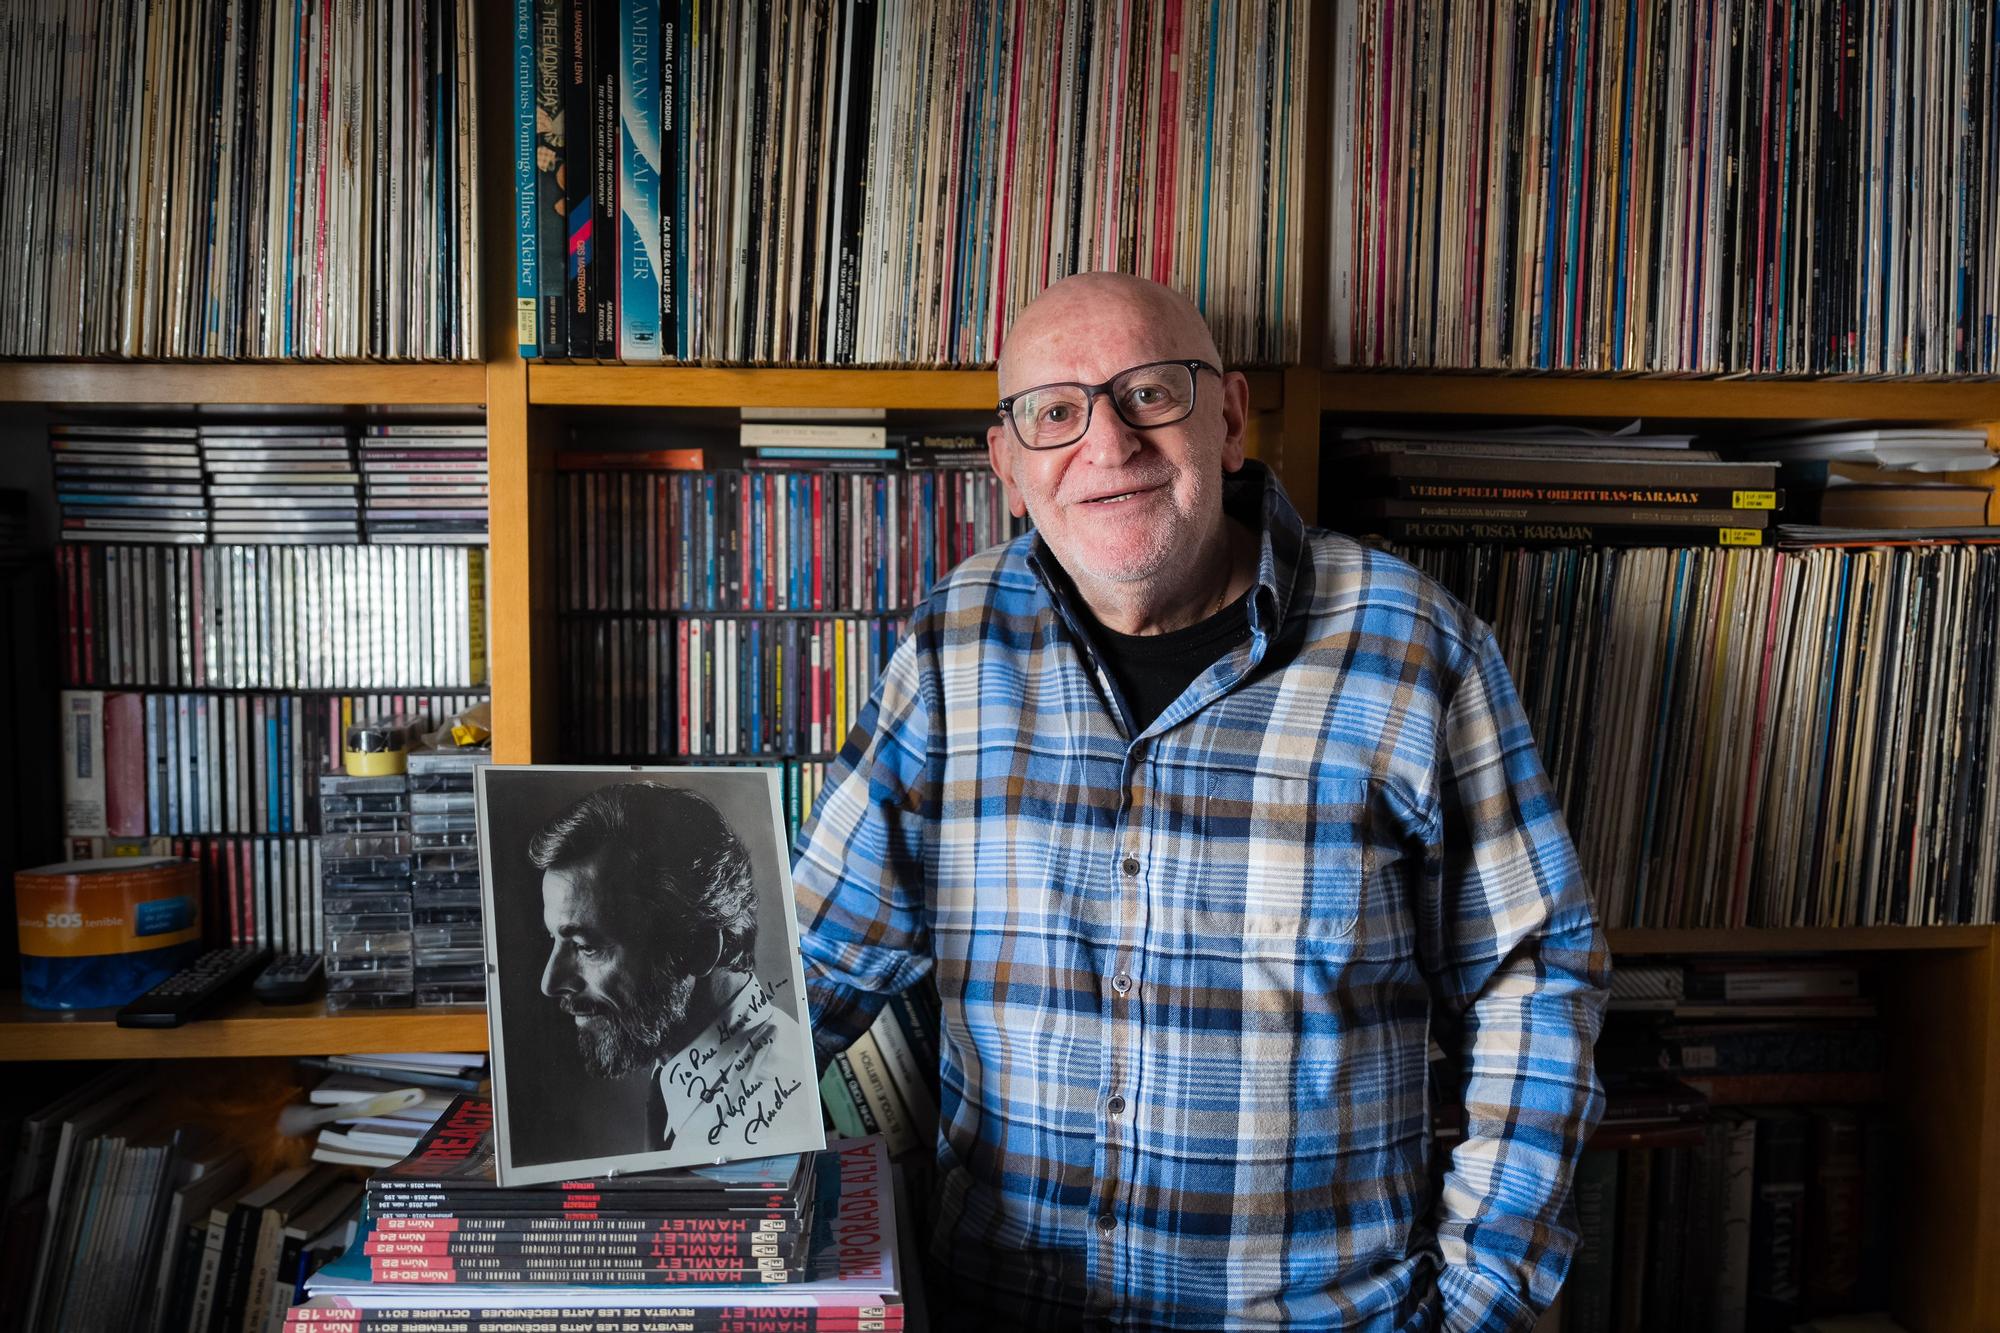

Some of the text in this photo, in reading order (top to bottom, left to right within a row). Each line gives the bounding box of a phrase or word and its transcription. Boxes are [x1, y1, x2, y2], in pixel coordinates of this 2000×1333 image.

[632, 2, 649, 99] AMERICAN
[542, 8, 559, 107] TREEMONISHA
[519, 44, 534, 109] Cotrubas
[663, 22, 674, 131] ORIGINAL CAST RECORDING
[598, 85, 606, 98] THE
[598, 124, 606, 147] CARTE
[518, 115, 533, 178] Domingo
[605, 75, 614, 218] GILBERT AND SULLIVAN THE GONDOLIERS
[598, 148, 606, 171] OPERA
[598, 172, 606, 206] COMPANY
[520, 182, 536, 228] Milnes
[663, 216, 671, 232] RCA
[663, 233, 671, 248] RED
[520, 234, 537, 286] Kleiber
[663, 249, 671, 268] SEAL
[576, 240, 587, 313] CBS MASTERWORKS
[663, 294, 671, 313] 5054
[598, 309, 606, 342] RECORDS
[606, 300, 614, 342] ARABESQUE
[1408, 484, 1700, 505] VERDI PRELUDIOS Y OBERTURAS KARAJAN
[1405, 522, 1593, 541] PUCCINI TOSCA KARAJAN
[46, 912, 83, 929] SOS
[669, 1063, 692, 1086] To
[859, 1103, 876, 1128] JOHN
[839, 1143, 878, 1184] ALTA
[388, 1219, 405, 1229] 25
[406, 1218, 435, 1229] Núm
[466, 1219, 481, 1229] 2012
[483, 1219, 505, 1229] ABRIL
[574, 1219, 590, 1230] ARTS
[592, 1219, 604, 1230] LES
[606, 1219, 616, 1230] DE
[618, 1219, 646, 1230] REVISTA
[659, 1219, 746, 1231] HAMLET
[379, 1232, 395, 1242] 24
[396, 1231, 426, 1242] Núm
[459, 1232, 475, 1242] 2012
[477, 1232, 497, 1242] MARÇ
[565, 1232, 582, 1243] ARTS
[583, 1232, 595, 1243] LES
[597, 1232, 607, 1243] DE
[608, 1232, 637, 1243] REVISTA
[651, 1231, 738, 1243] HAMLET
[838, 1187, 882, 1281] TEMPORADA
[377, 1243, 395, 1254] 23
[395, 1243, 423, 1254] Núm
[450, 1244, 466, 1254] 2012
[468, 1244, 495, 1255] FEBRER
[563, 1245, 580, 1255] ARTS
[582, 1245, 594, 1255] LES
[596, 1245, 605, 1255] DE
[606, 1245, 636, 1255] REVISTA
[650, 1244, 738, 1256] HAMLET
[381, 1258, 395, 1268] 22
[395, 1257, 428, 1269] Núm
[459, 1258, 473, 1268] 2012
[474, 1258, 500, 1269] GENER
[571, 1258, 587, 1268] ARTS
[588, 1258, 601, 1268] LES
[602, 1258, 612, 1268] DE
[613, 1258, 642, 1268] REVISTA
[656, 1257, 744, 1269] HAMLET
[382, 1270, 419, 1281] 20-21
[421, 1270, 448, 1281] Núm
[467, 1270, 483, 1280] 2011
[484, 1270, 521, 1281] NOVEMBRE
[573, 1270, 590, 1281] ARTS
[591, 1270, 604, 1281] LES
[605, 1270, 615, 1281] DE
[616, 1270, 646, 1281] REVISTA
[664, 1270, 742, 1281] HAMLET
[298, 1308, 321, 1320] 19
[377, 1309, 410, 1319] 2011
[412, 1309, 471, 1319] OCTUBRE
[480, 1308, 560, 1319] ESCÈNIQUES
[563, 1308, 596, 1318] ARTS
[597, 1308, 622, 1318] LES
[624, 1308, 641, 1318] DE
[644, 1308, 696, 1318] REVISTA
[719, 1306, 809, 1318] HAMLET
[294, 1321, 318, 1333] 18
[366, 1323, 400, 1333] 2011
[402, 1323, 468, 1333] SETEMBRE
[479, 1322, 559, 1333] ESCÈNIQUES
[561, 1322, 594, 1333] ARTS
[594, 1322, 620, 1332] LES
[622, 1322, 639, 1332] DE
[641, 1322, 694, 1332] REVISTA
[718, 1321, 808, 1333] HAMLET
